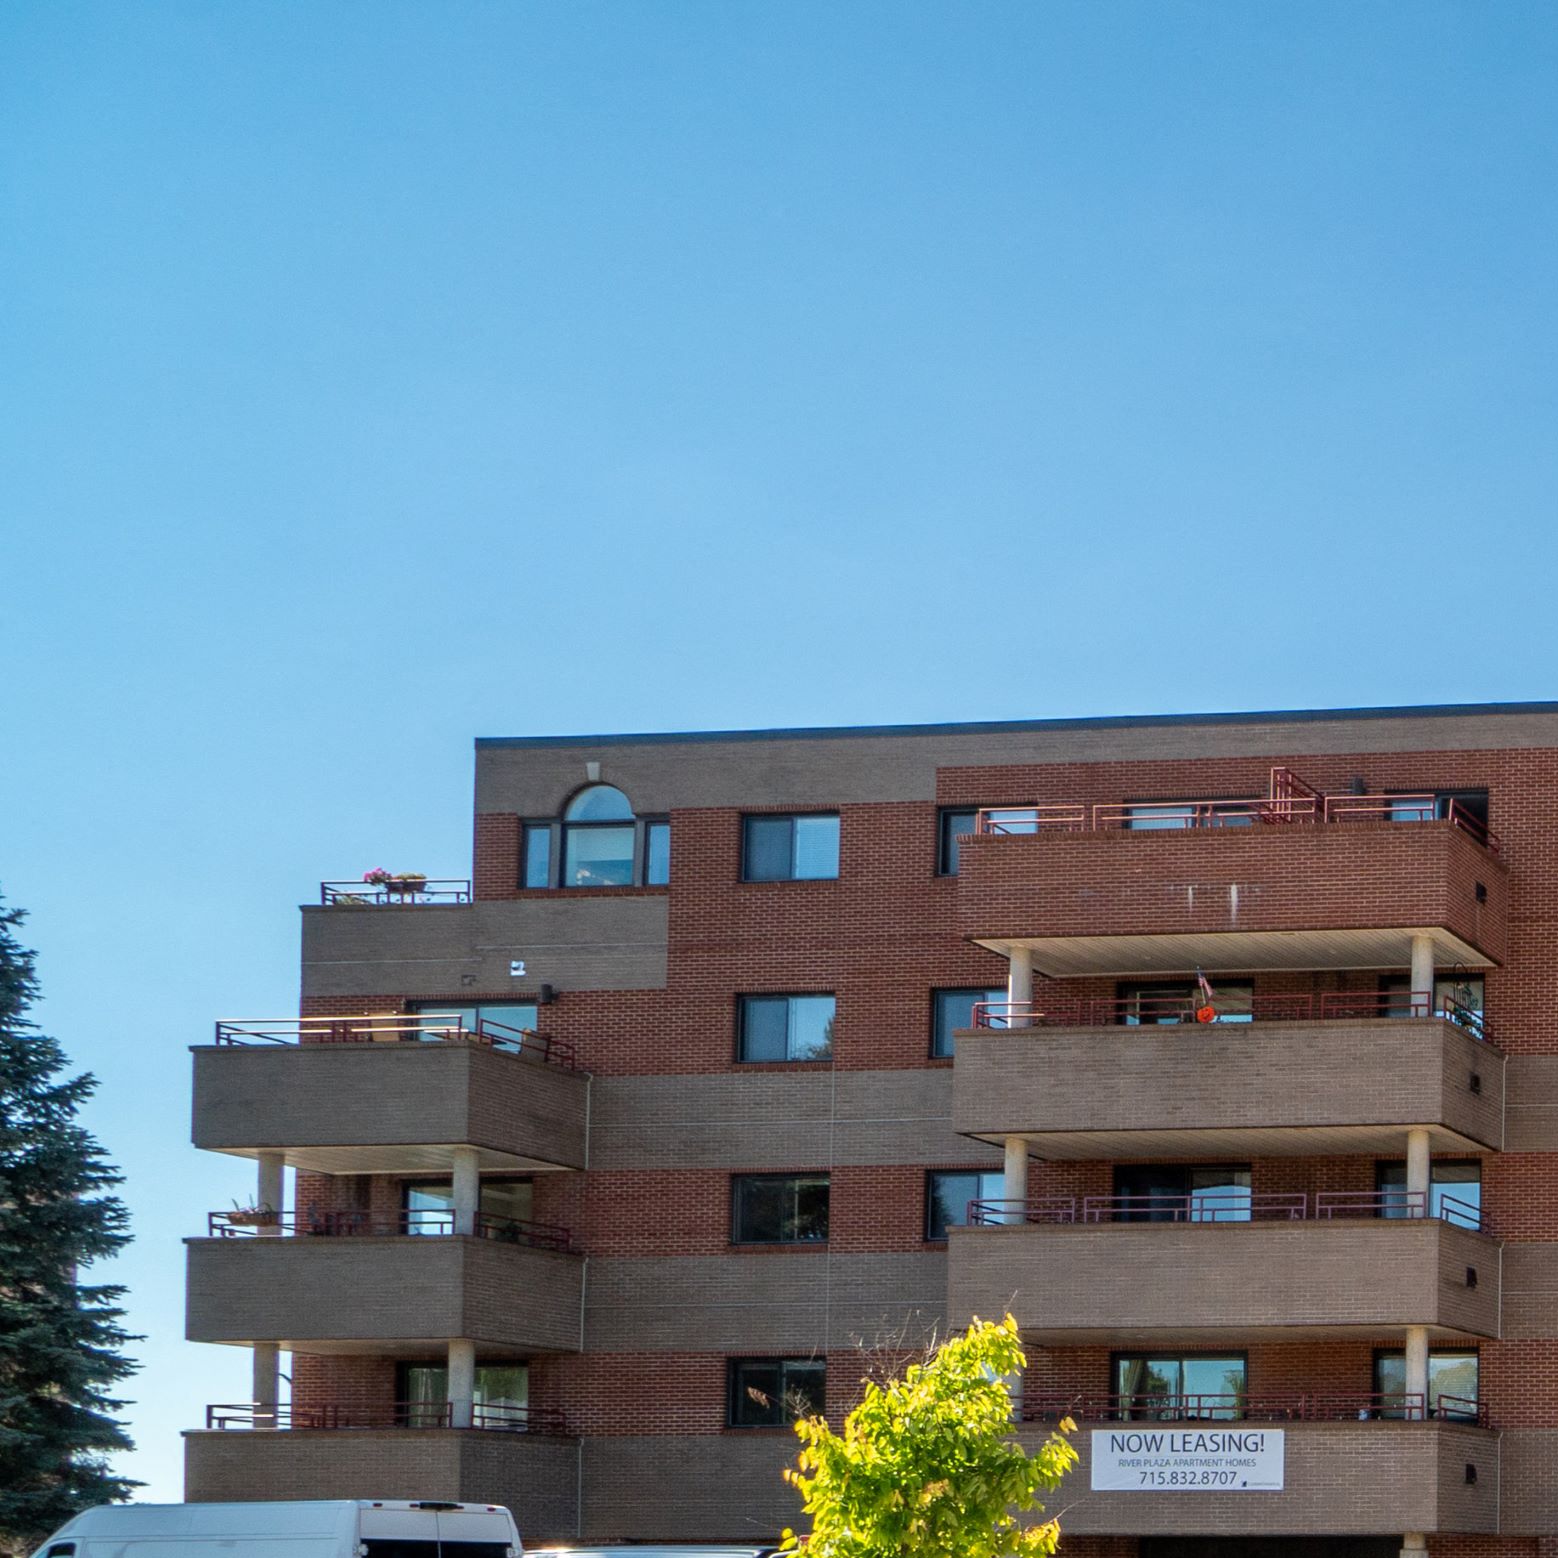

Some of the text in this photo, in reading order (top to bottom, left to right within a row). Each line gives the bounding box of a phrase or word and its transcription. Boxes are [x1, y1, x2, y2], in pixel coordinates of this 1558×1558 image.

[1110, 1433, 1265, 1453] NOW LEASING!
[1118, 1458, 1257, 1468] RIVER PLAZA APARTMENT HOMES
[1139, 1471, 1238, 1486] 715.832.8707
